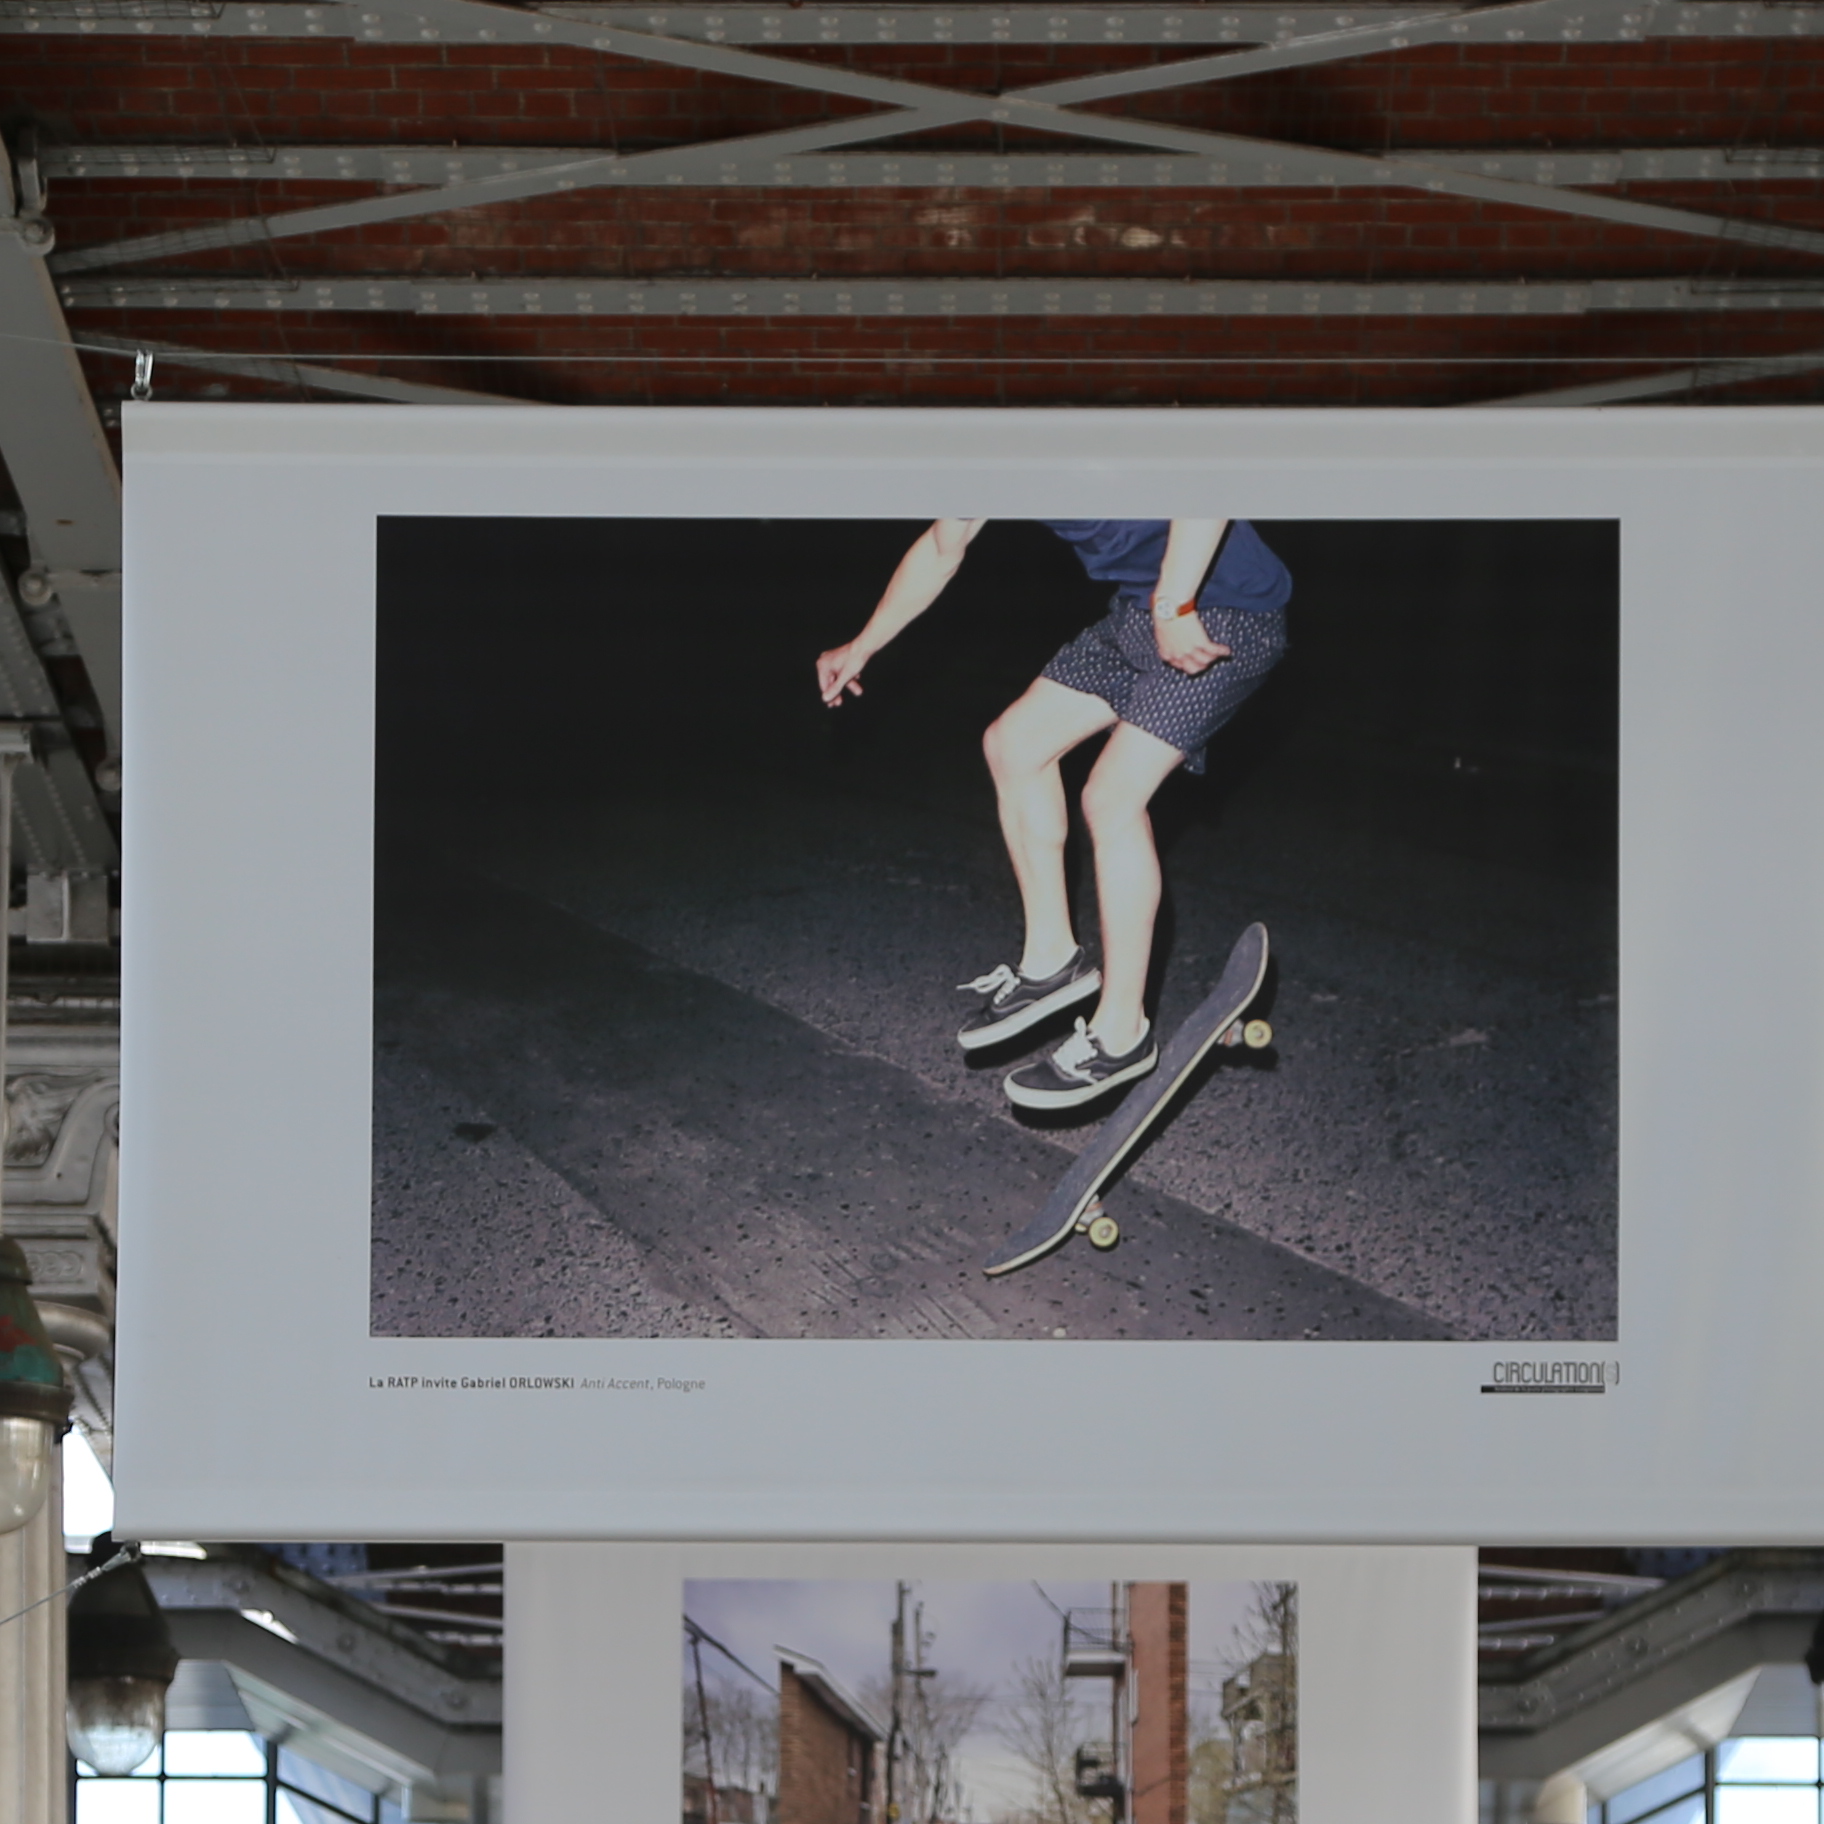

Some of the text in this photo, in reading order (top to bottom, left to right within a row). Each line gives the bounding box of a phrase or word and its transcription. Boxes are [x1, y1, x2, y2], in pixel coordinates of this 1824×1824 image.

[369, 1376, 706, 1392] La RATP invite Gabriel ORLOWSKI Anti Accent, Pologne
